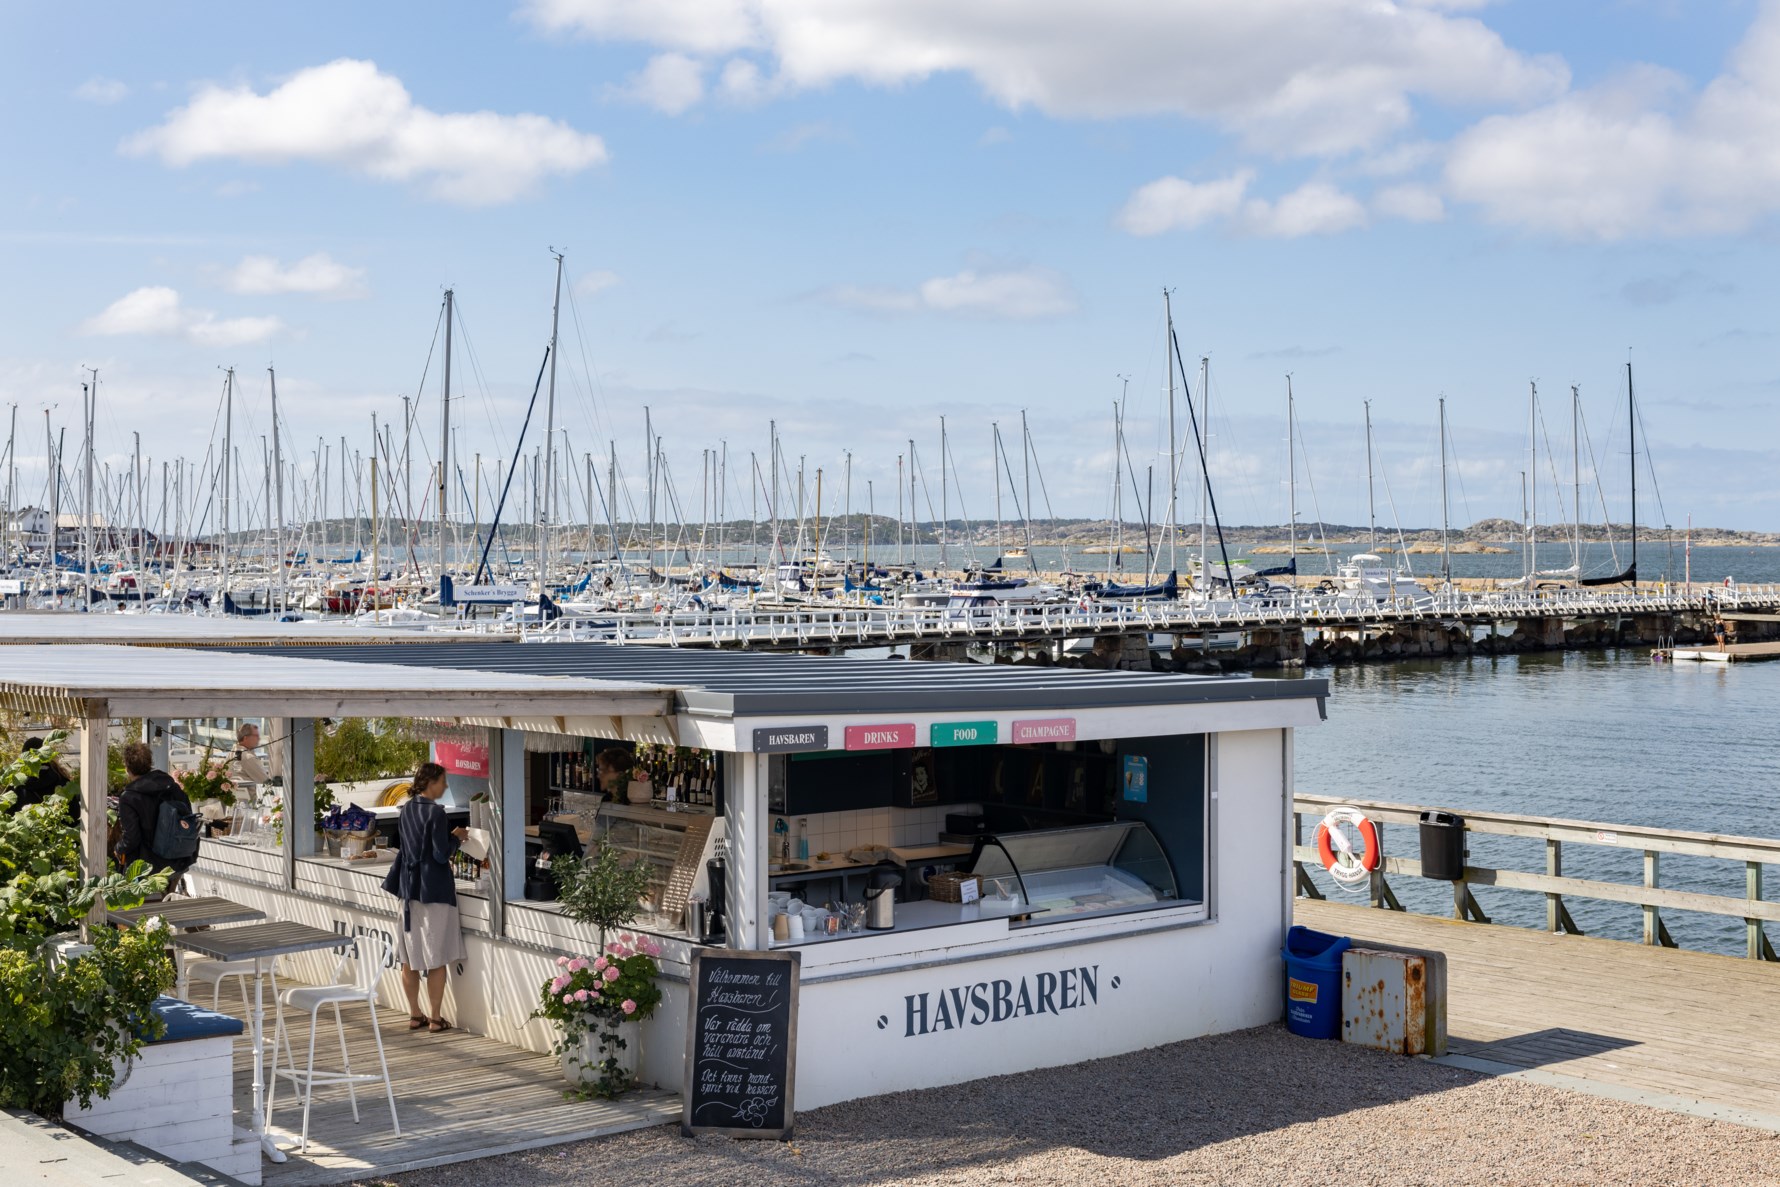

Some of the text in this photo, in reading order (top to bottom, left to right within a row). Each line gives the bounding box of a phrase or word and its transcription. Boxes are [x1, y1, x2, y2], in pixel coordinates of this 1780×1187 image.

[497, 589, 517, 597] Brygga
[863, 731, 899, 744] DRINKS
[953, 728, 977, 741] FOOD
[1020, 725, 1070, 738] CHAMPAGNE
[768, 733, 815, 745] HAVSBAREN
[455, 759, 481, 771] HAVSBAREN
[708, 966, 782, 986] Välkommen till
[904, 965, 1099, 1038] HAVSBAREN
[704, 1014, 772, 1033] Var rädda om
[703, 1032, 772, 1046] varandra och
[702, 1044, 723, 1058] håll
[700, 1068, 718, 1081] Det
[720, 1070, 742, 1083] finns
[700, 1083, 722, 1095] sprit
[725, 1083, 741, 1094] vid
